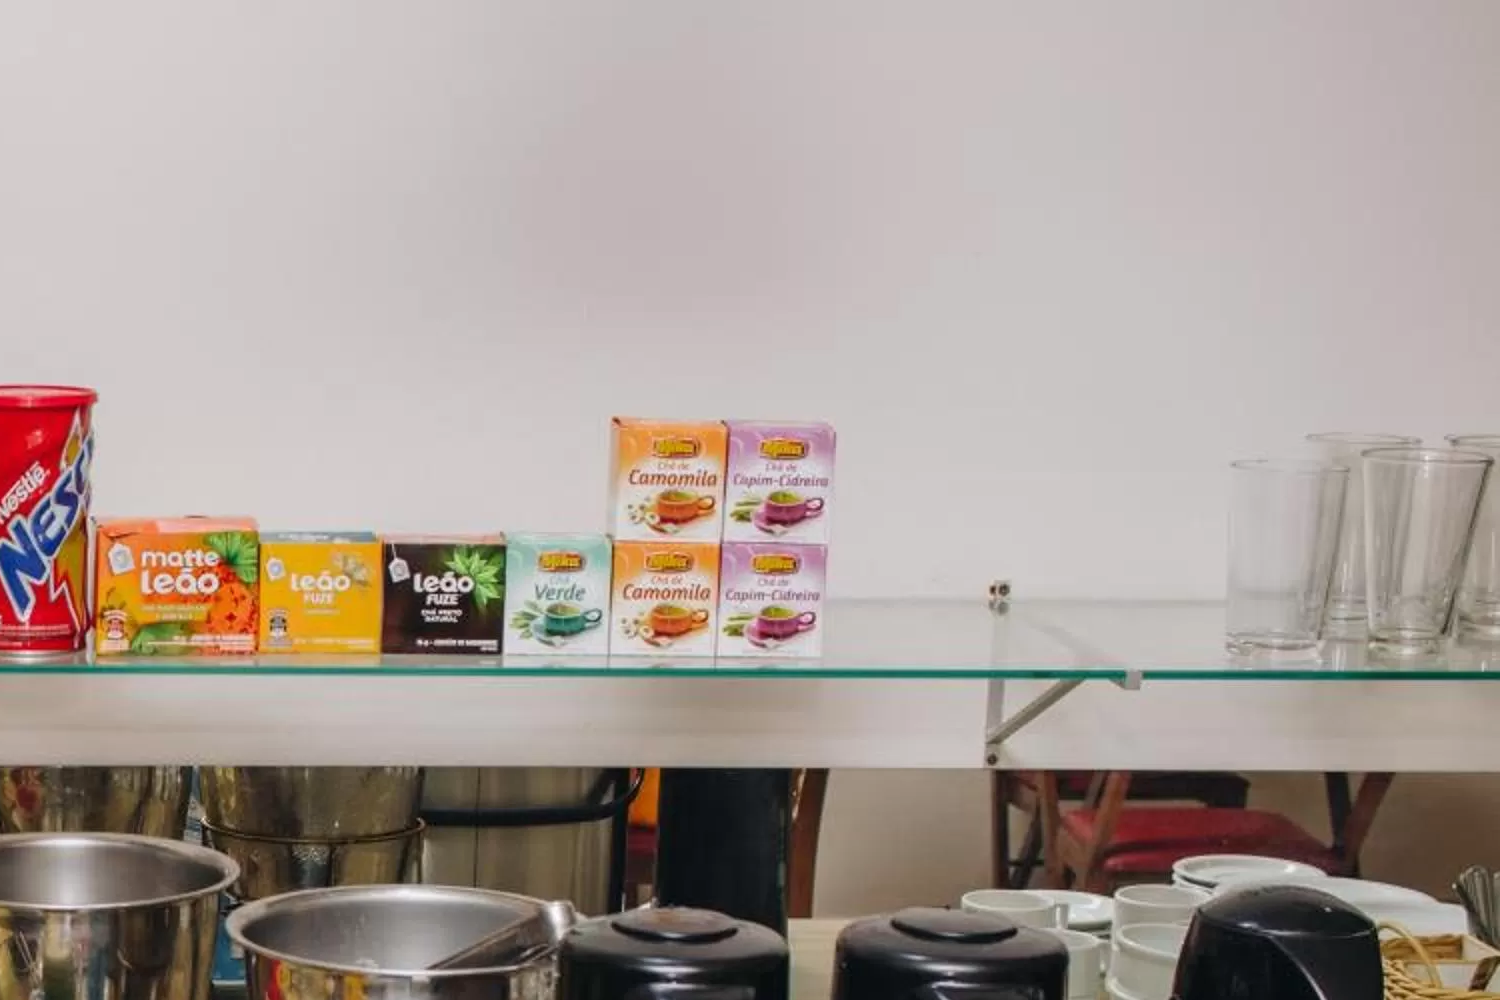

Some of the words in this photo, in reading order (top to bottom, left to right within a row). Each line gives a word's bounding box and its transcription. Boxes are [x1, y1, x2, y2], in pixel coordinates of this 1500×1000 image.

[628, 469, 718, 488] Camomila
[732, 472, 830, 489] Capim-Cidreira
[140, 549, 220, 568] matte
[534, 582, 587, 602] Verde
[622, 583, 711, 601] Camomila
[725, 587, 820, 602] Capim-Cidreira
